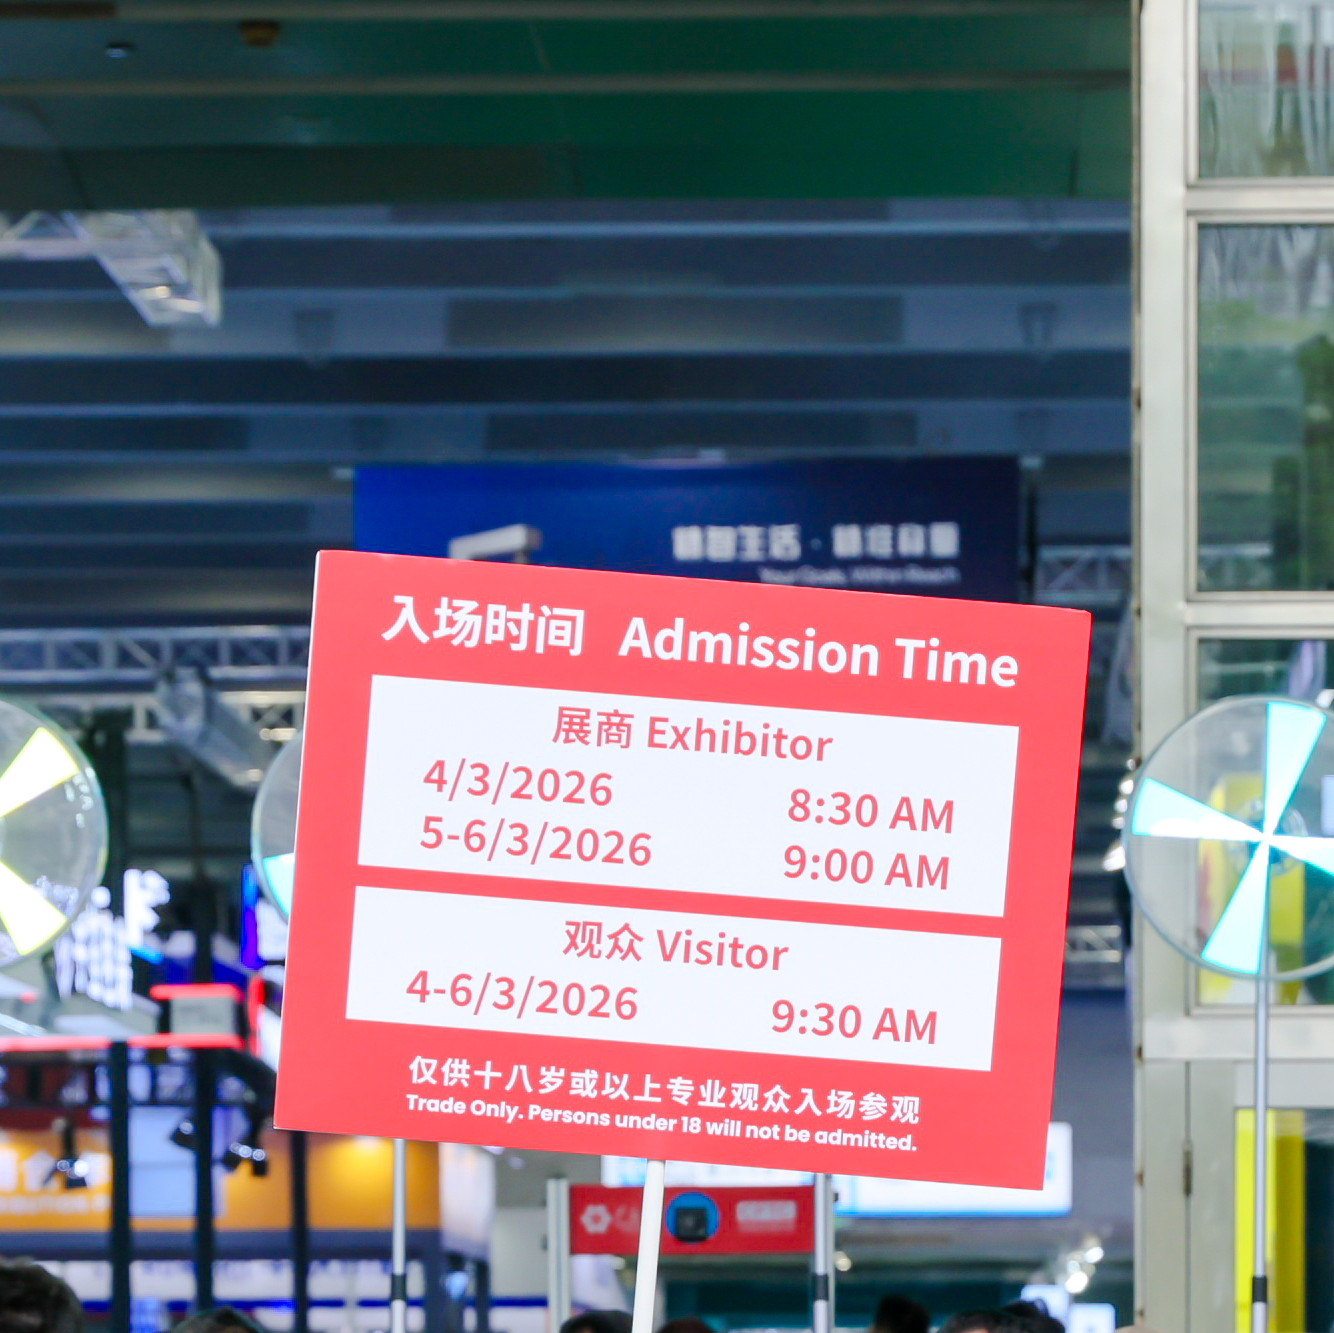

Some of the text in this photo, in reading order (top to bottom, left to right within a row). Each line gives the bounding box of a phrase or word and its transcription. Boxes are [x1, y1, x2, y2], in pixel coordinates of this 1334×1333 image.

[381, 595, 1020, 688] 入场时间 Admission Time
[551, 706, 835, 763] 展商 Exhibitor
[422, 757, 955, 835] 4/3/2026 8:30 AM
[418, 814, 950, 891] 5-6/3/2026 9:00 AM
[561, 919, 789, 973] 观众 Visitor
[406, 970, 938, 1046] 4-6/3/2026 9:30 AM
[406, 1094, 918, 1153] Trade Only. Persons under 18 will not be admitted.
[409, 1055, 921, 1125] 仅供十八岁或以上专业观众入场参观
